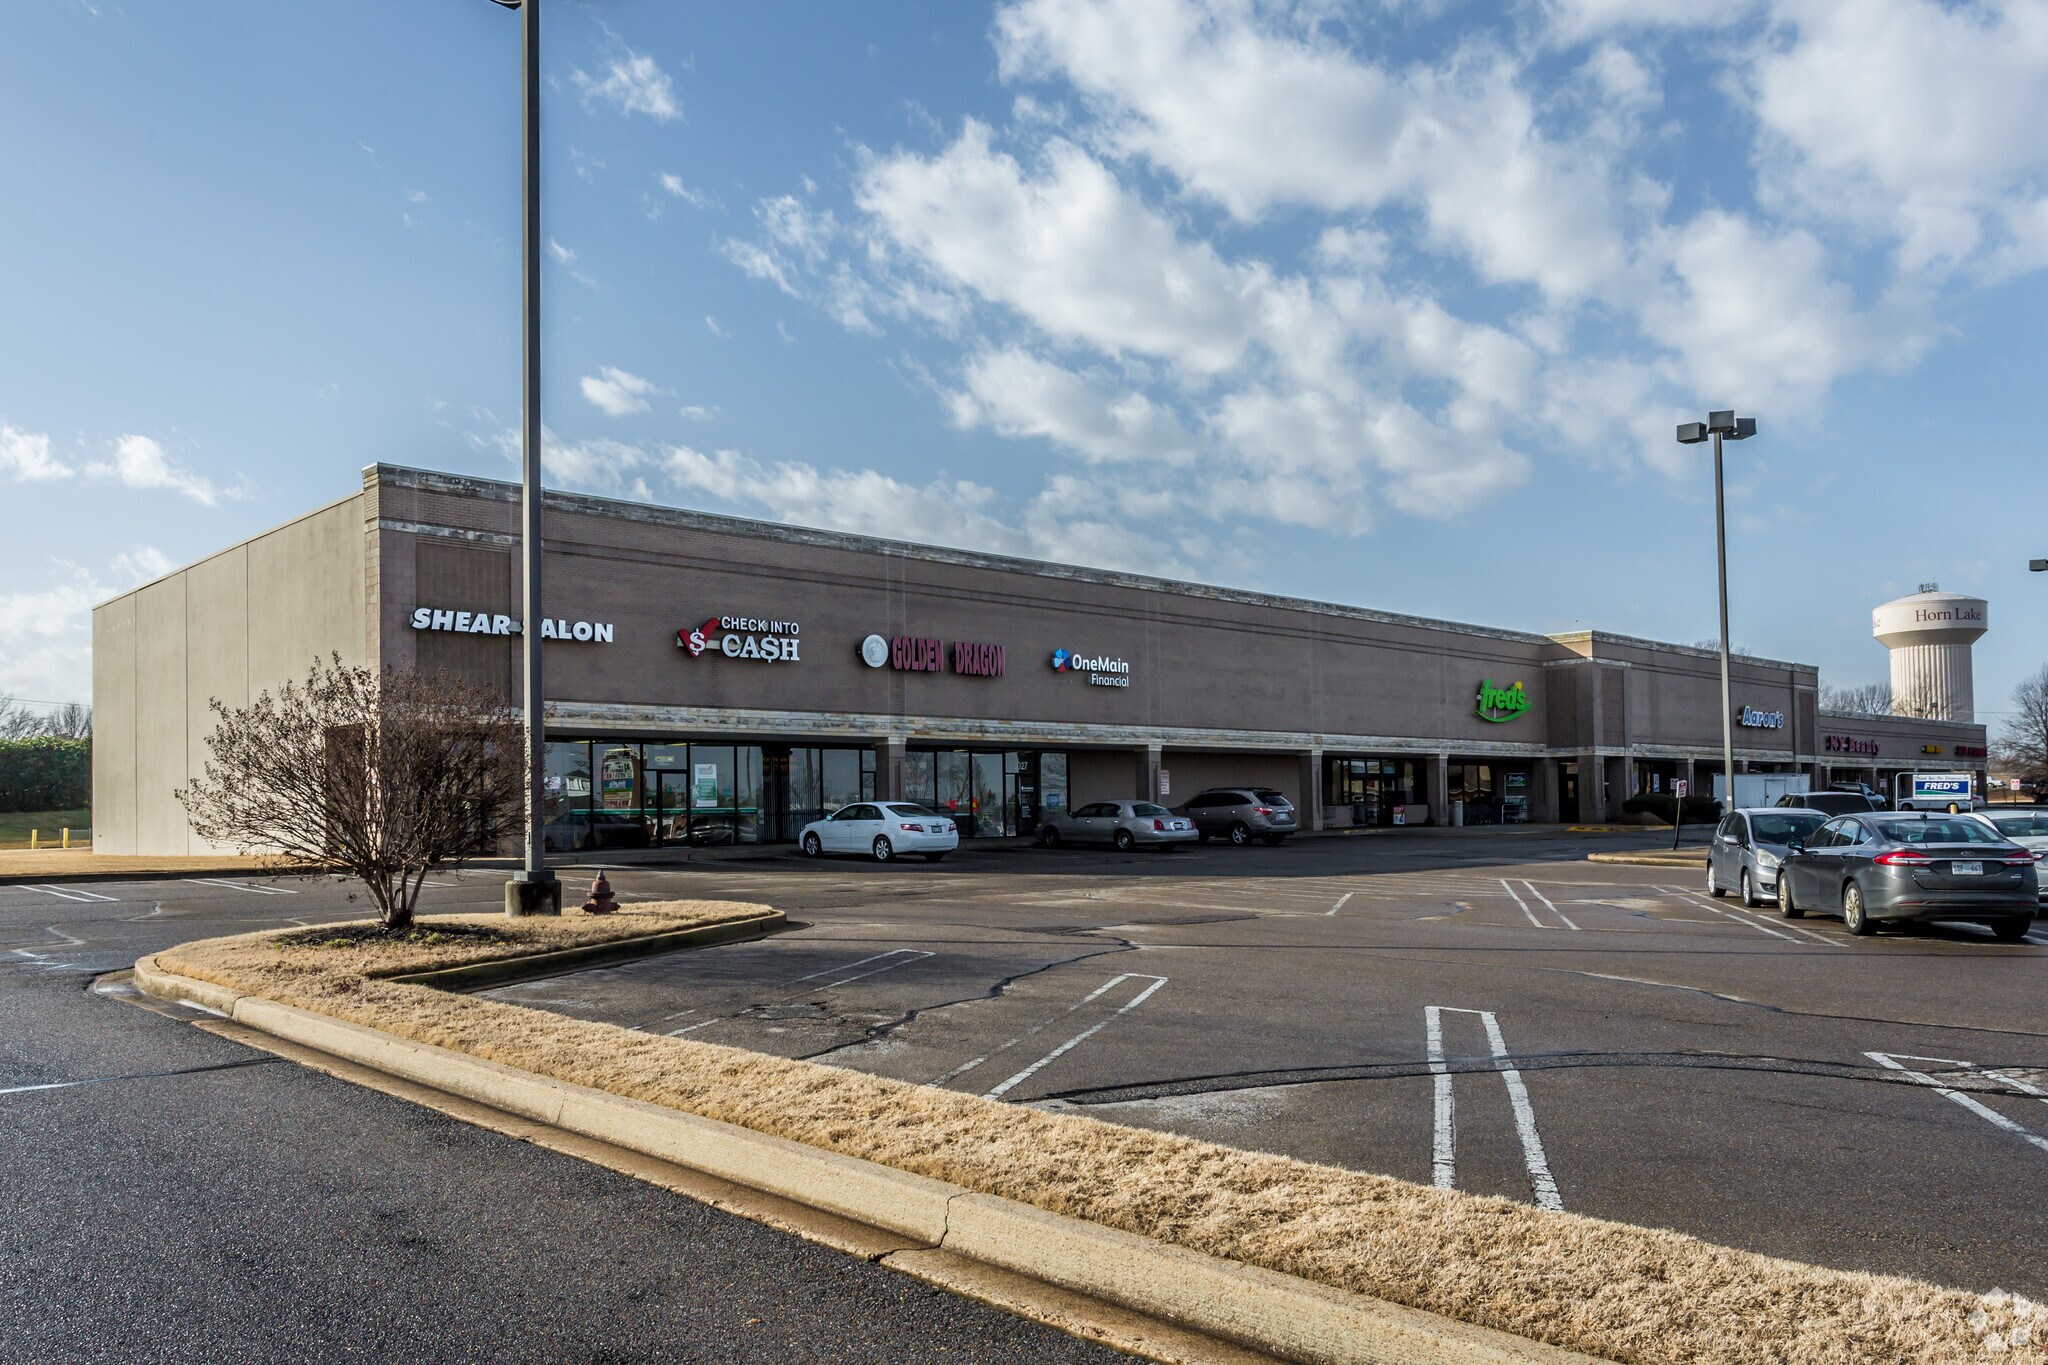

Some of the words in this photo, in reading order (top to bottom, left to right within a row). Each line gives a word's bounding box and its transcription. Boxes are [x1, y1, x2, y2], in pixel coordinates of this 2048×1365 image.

[412, 607, 510, 636] SHEAR
[522, 618, 614, 643] ALON
[1915, 609, 1951, 622] Horn
[1954, 608, 1981, 621] Lake
[721, 616, 766, 633] CHECK
[770, 620, 800, 636] INTO
[891, 635, 944, 672] GOLDEN
[954, 641, 1006, 677] DRAGON
[1072, 653, 1130, 673] OneMain
[1091, 673, 1130, 687] Financial
[1480, 678, 1527, 712] fred's
[1742, 705, 1785, 729] Aaron's
[1923, 782, 1960, 790] FRED'S
